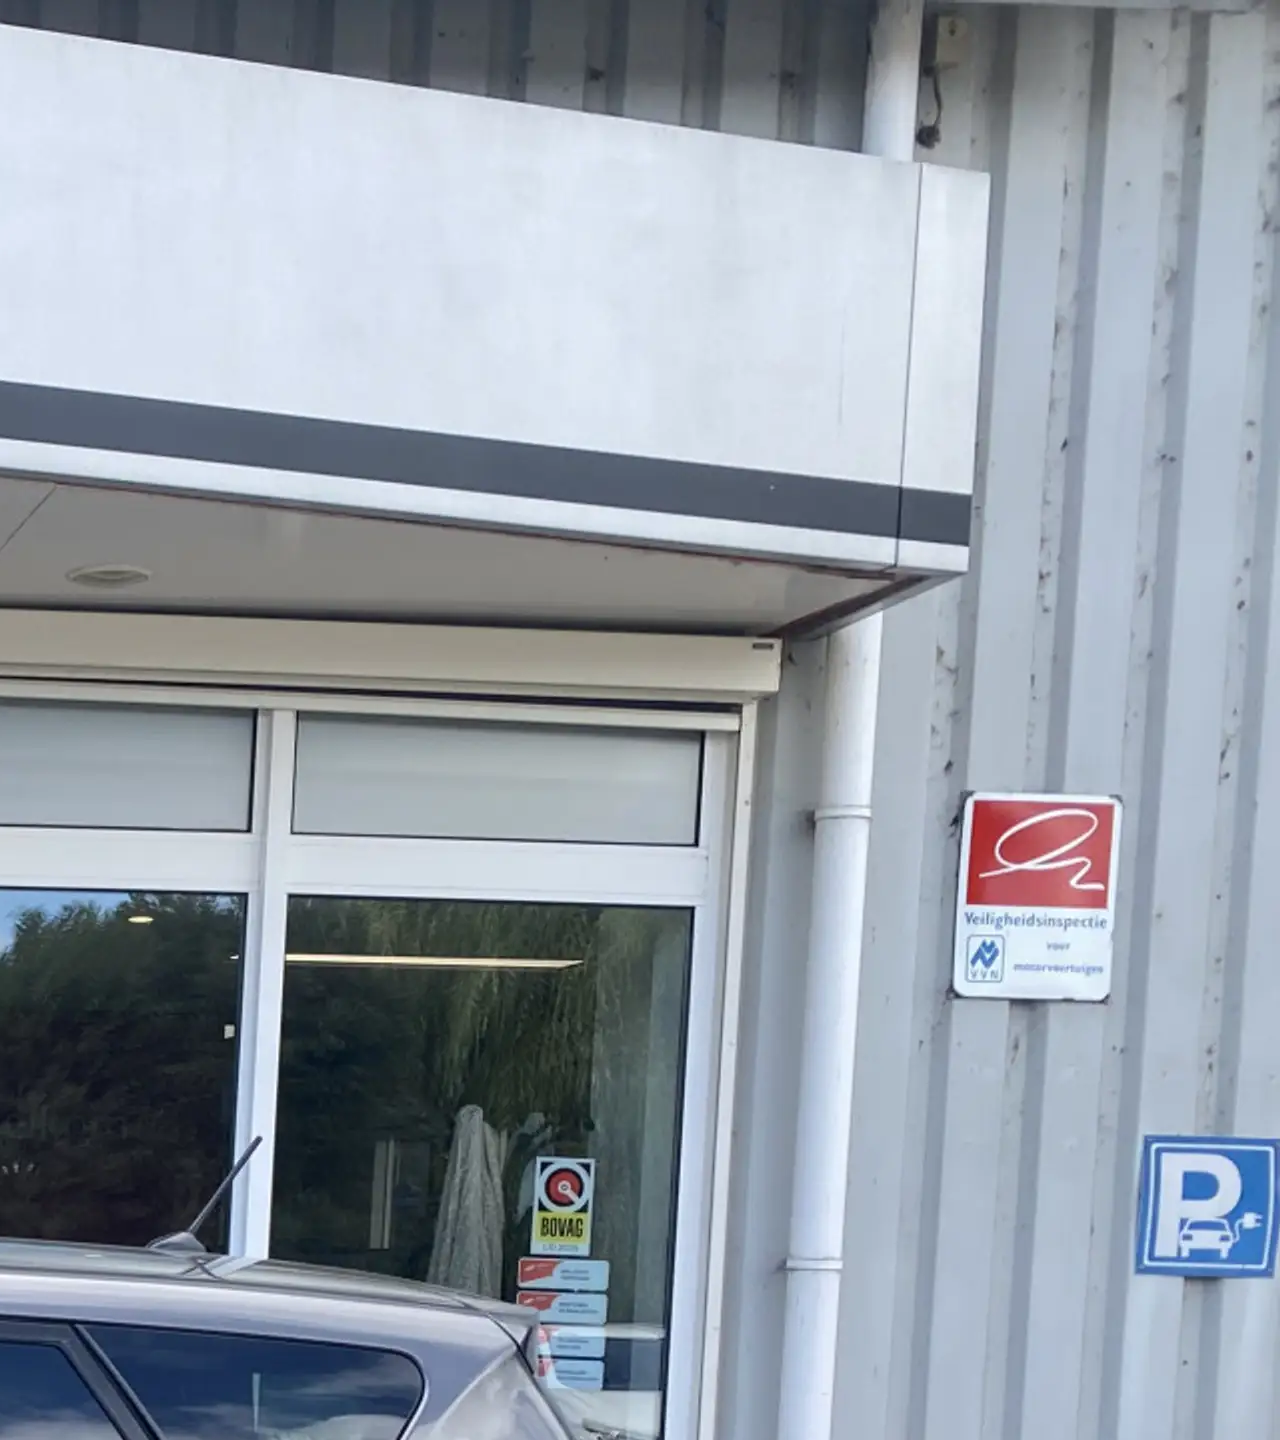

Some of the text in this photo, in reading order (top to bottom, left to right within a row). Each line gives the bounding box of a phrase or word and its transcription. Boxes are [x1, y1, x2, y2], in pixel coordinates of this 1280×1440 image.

[964, 911, 1108, 931] Veiligheidsinspectie
[1154, 1152, 1242, 1257] P
[540, 1217, 584, 1238] BOVAG
